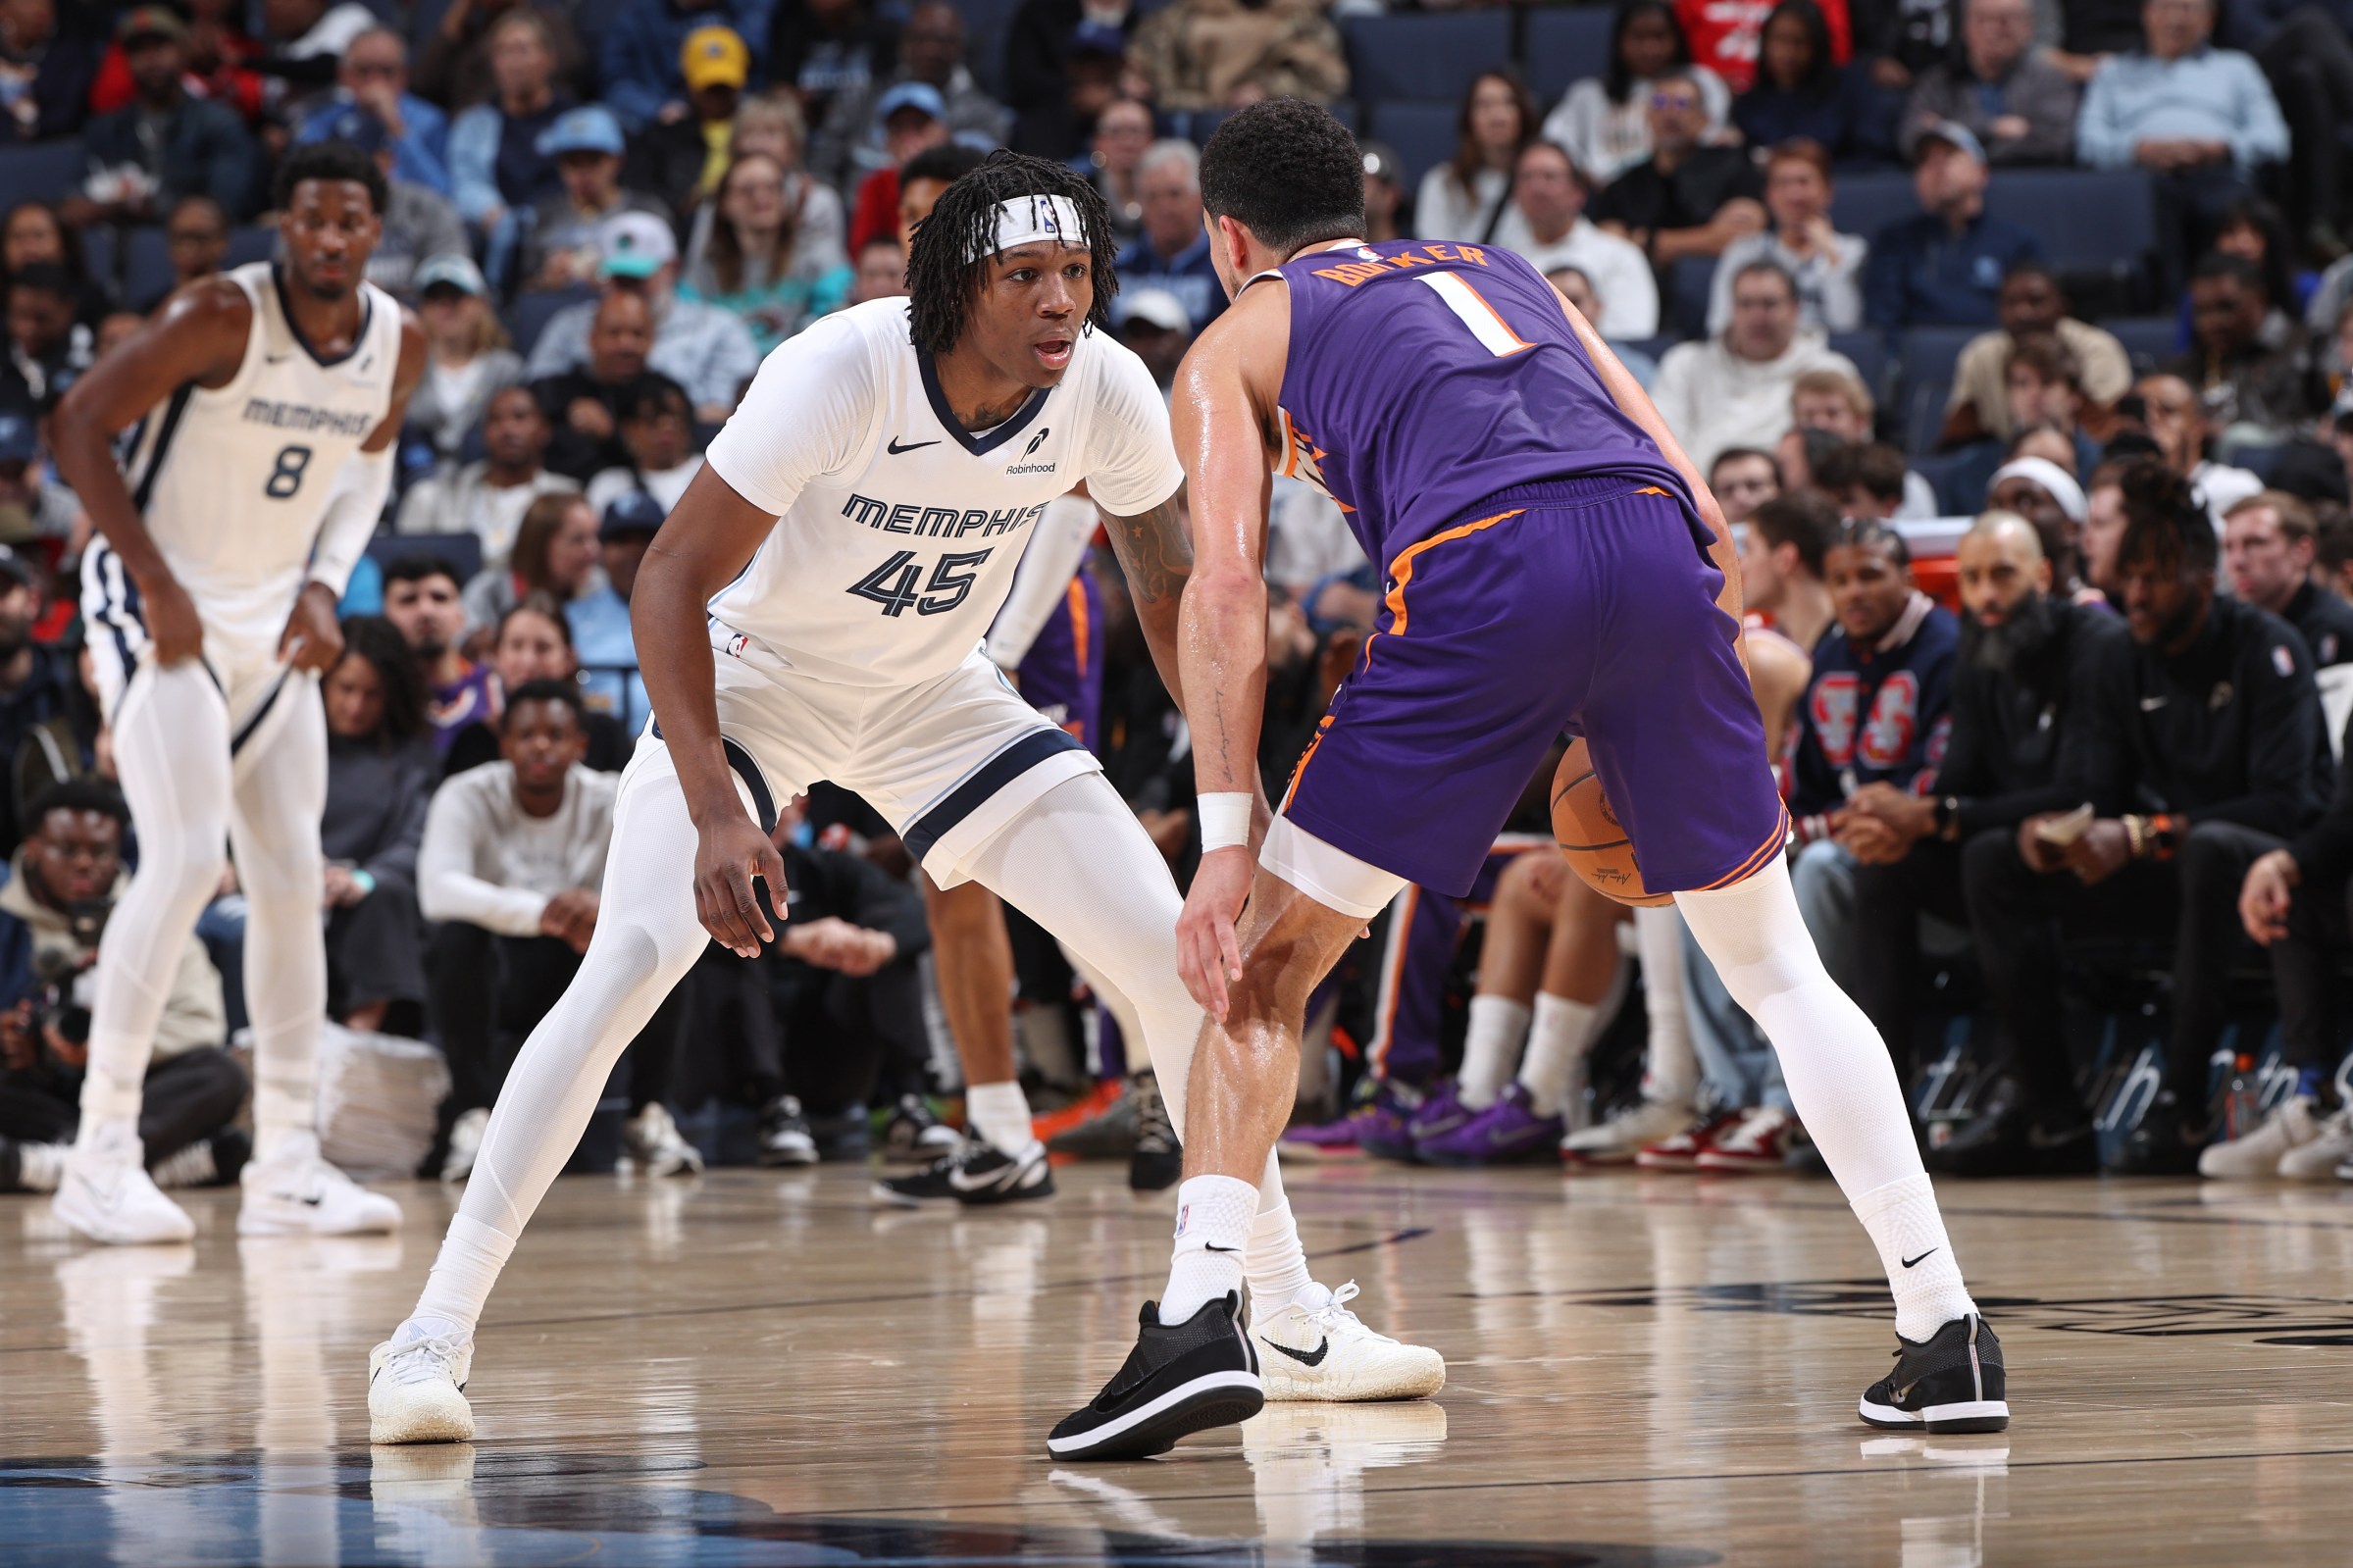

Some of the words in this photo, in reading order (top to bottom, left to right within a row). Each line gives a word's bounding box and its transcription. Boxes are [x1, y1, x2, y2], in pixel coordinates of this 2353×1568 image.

[1412, 271, 1538, 357] 1
[243, 398, 371, 435] MEMPHIS
[265, 444, 313, 498] 8
[1005, 462, 1055, 476] Robinhood
[844, 546, 996, 618] 45
